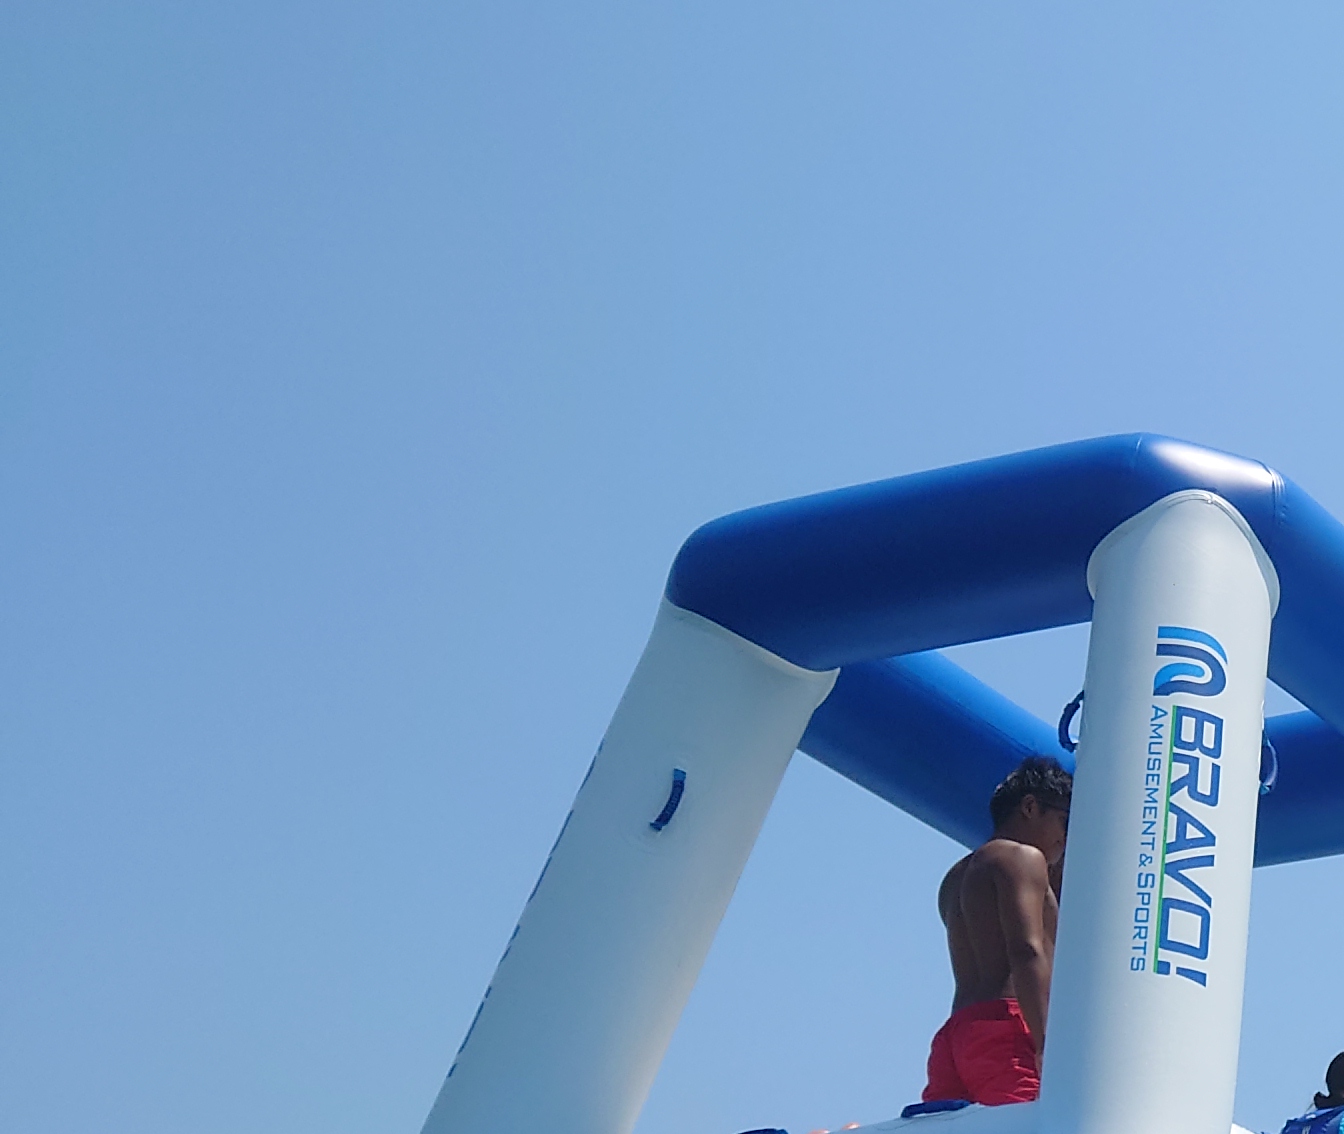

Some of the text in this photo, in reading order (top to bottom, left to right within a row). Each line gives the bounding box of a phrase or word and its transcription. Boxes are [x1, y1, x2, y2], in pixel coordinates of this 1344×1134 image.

[1130, 703, 1169, 973] AMUSEMENT & SPORTS
[1156, 705, 1225, 989] BRAVO!
